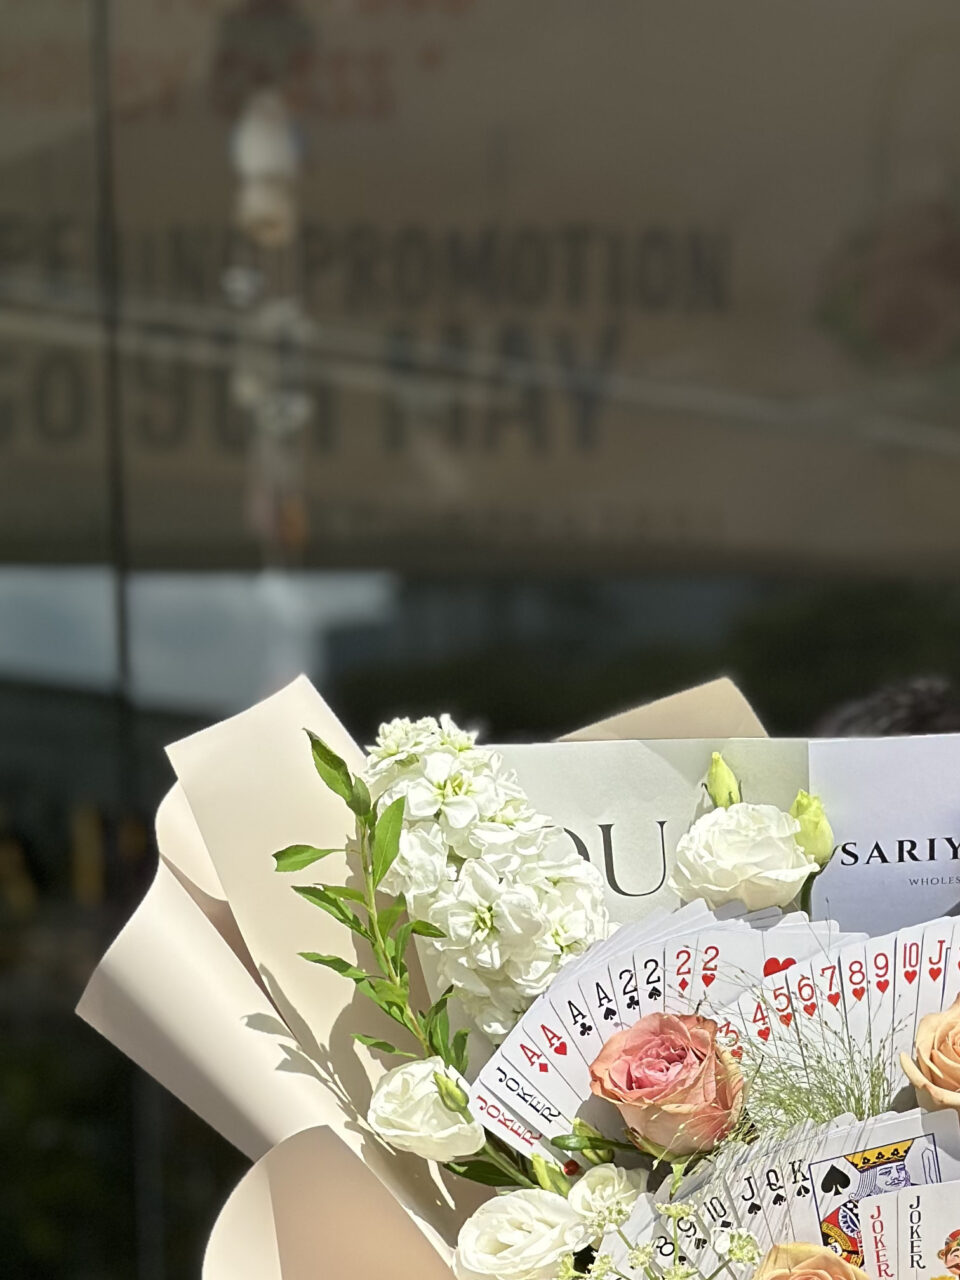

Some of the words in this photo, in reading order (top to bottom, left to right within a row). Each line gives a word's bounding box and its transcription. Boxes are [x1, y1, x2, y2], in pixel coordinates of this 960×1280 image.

[519, 1043, 543, 1067] A
[540, 1024, 563, 1048] A
[567, 1000, 586, 1025] A
[595, 981, 613, 1008] A
[619, 968, 637, 995] 2
[643, 958, 661, 985] 2
[675, 949, 692, 976] 2
[702, 945, 720, 972] 2
[719, 1020, 740, 1046] 3
[752, 1001, 768, 1026] 4
[773, 986, 790, 1013] 5
[797, 975, 815, 1002] 6
[820, 965, 836, 992] 7
[849, 960, 866, 986] 8
[873, 952, 889, 978] 9
[903, 942, 920, 968] 10
[928, 939, 946, 966] J
[476, 1095, 543, 1147] JOKER
[496, 1066, 561, 1123] JOKER
[655, 1235, 675, 1257] 8
[703, 1196, 727, 1223] 10
[741, 1176, 756, 1202] J
[766, 1168, 784, 1192] Q
[788, 1158, 810, 1185] K
[870, 1205, 894, 1278] JOKER
[909, 1196, 926, 1270] JOKER
